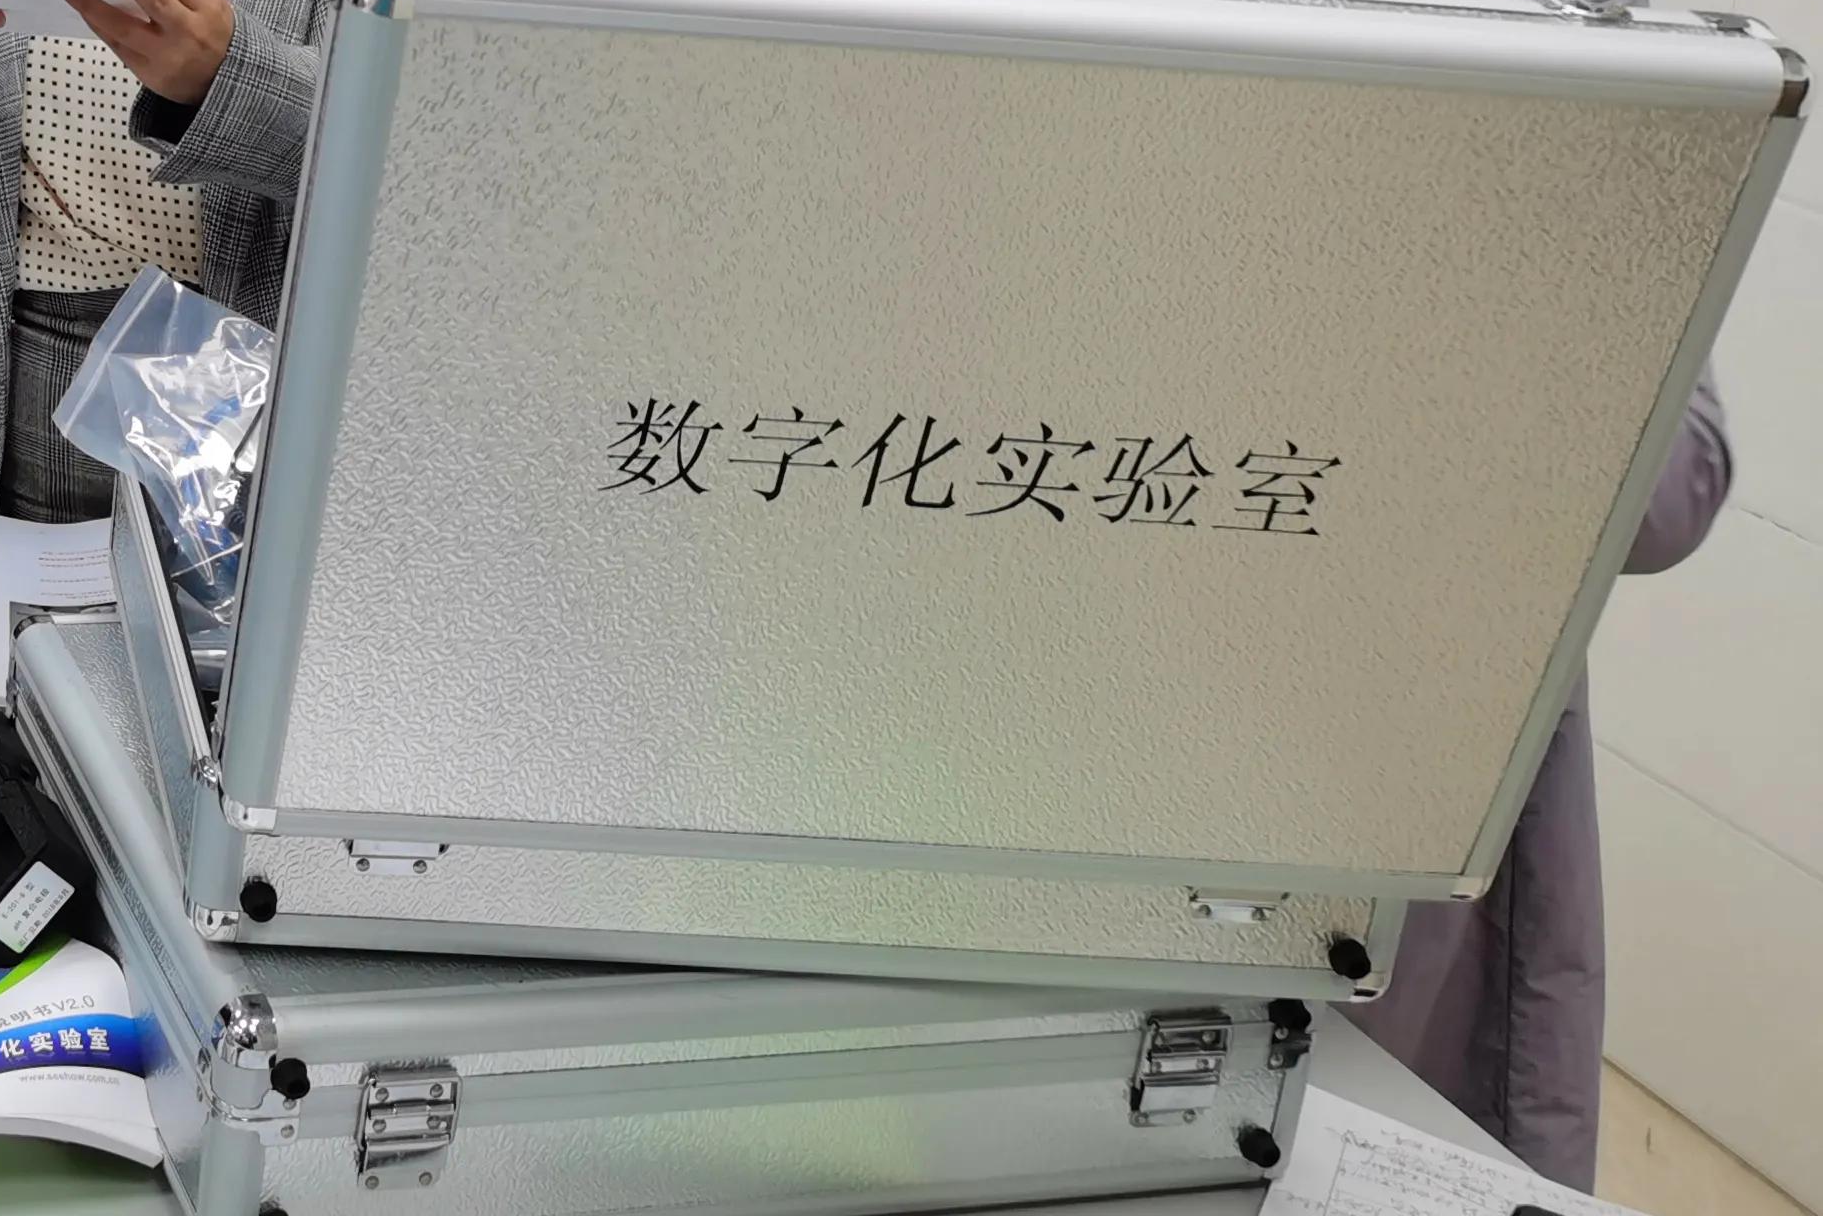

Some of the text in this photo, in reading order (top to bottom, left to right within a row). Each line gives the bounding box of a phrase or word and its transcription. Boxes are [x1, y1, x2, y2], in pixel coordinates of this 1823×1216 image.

[597, 396, 1343, 537] 数字化实验室
